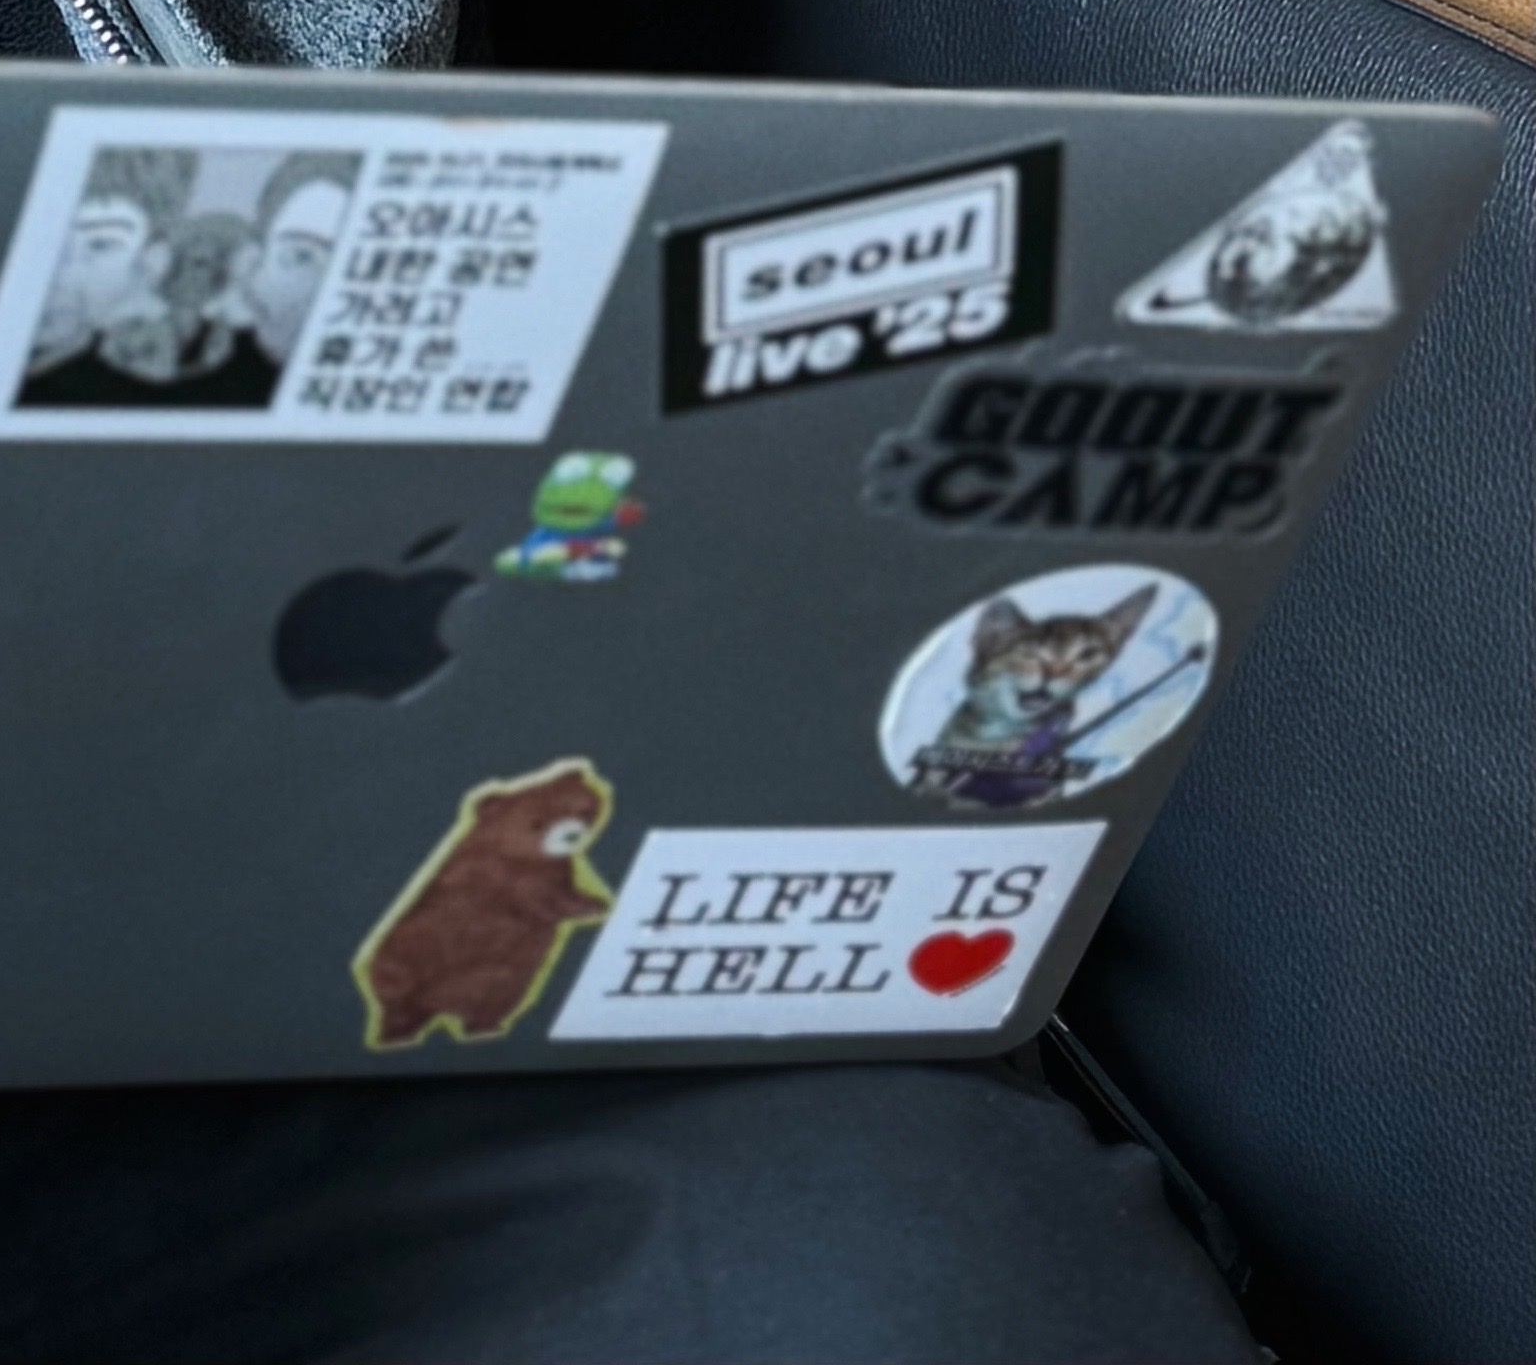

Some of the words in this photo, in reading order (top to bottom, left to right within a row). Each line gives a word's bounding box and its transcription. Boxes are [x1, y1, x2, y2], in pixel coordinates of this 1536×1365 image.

[364, 199, 538, 240] 오아시스
[346, 244, 437, 284] 내한
[447, 244, 540, 289] 공연
[743, 208, 978, 299] seoul
[325, 289, 463, 327] 가려고
[702, 321, 862, 399] live
[298, 373, 433, 412] 직장인
[910, 453, 1282, 533] CAMP
[640, 871, 894, 927] LIFE
[933, 864, 1048, 922] IS
[604, 941, 891, 998] HELL
